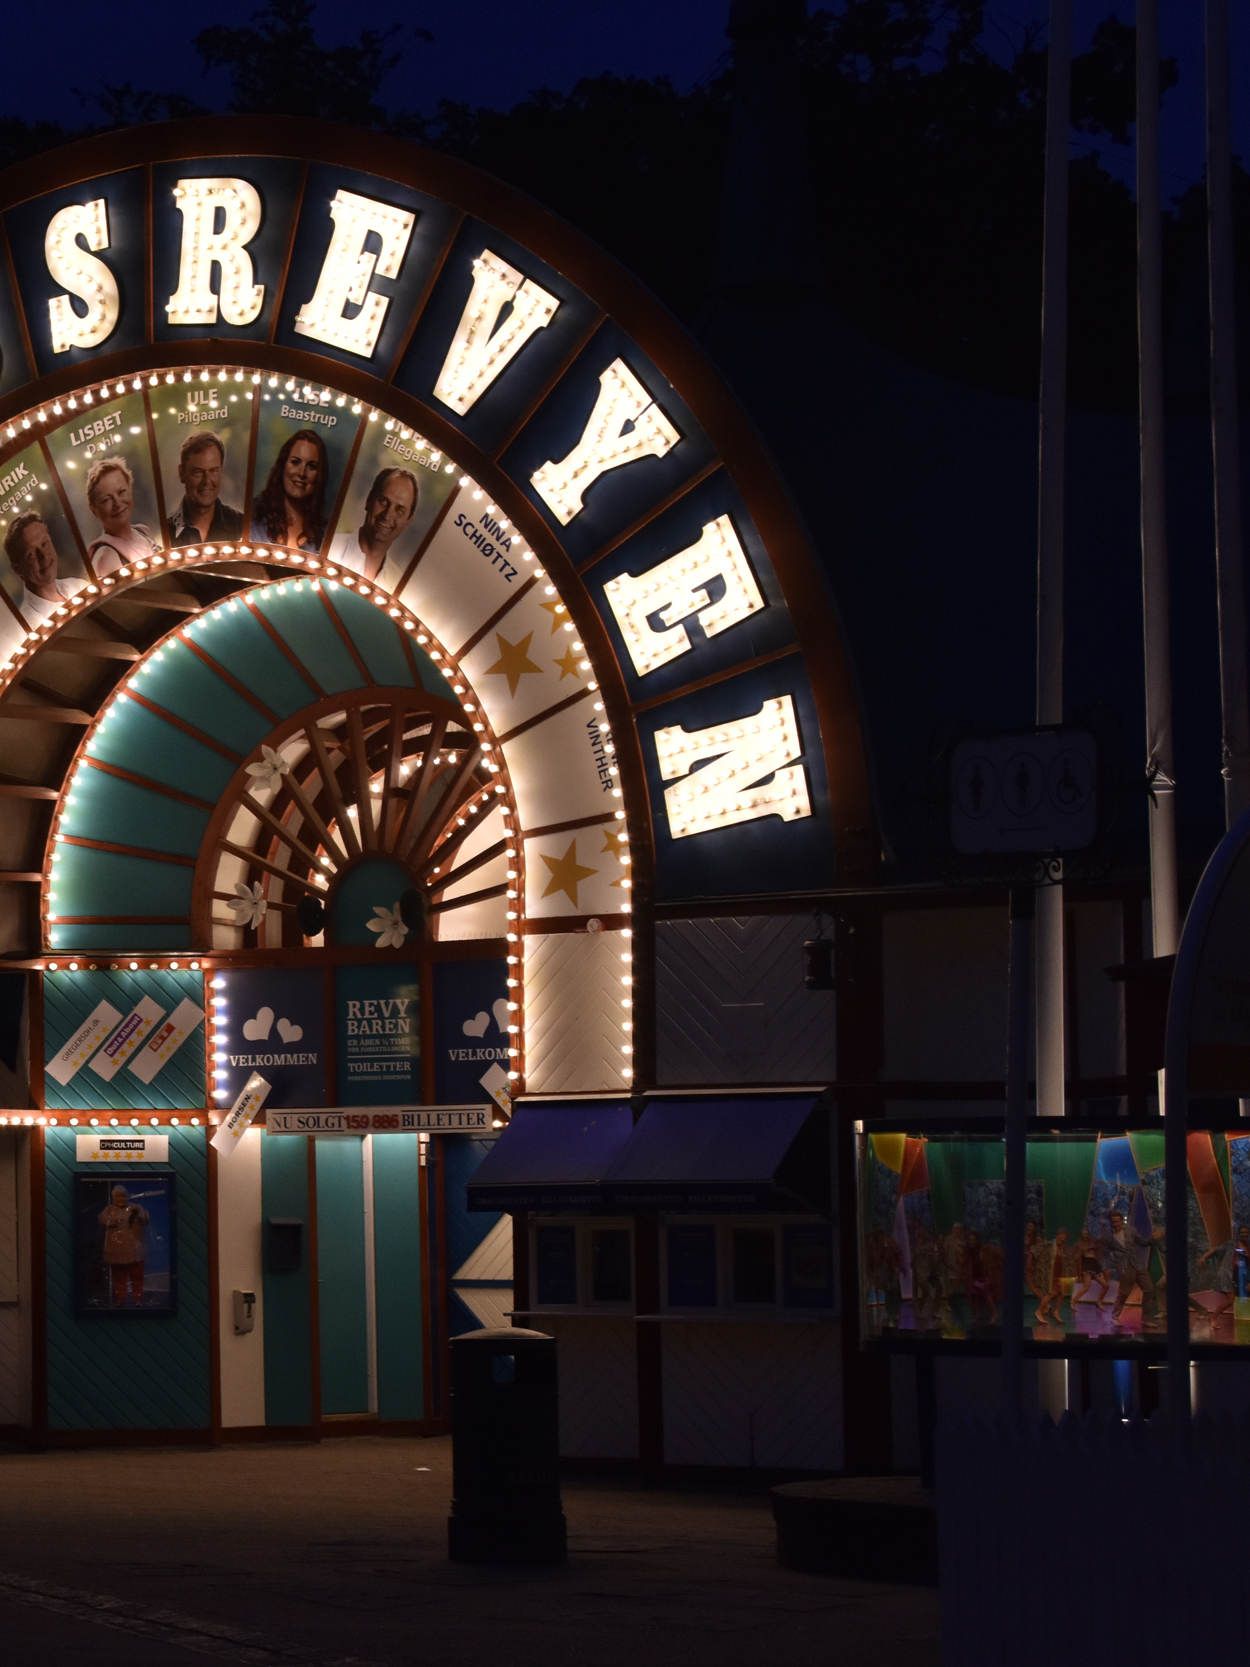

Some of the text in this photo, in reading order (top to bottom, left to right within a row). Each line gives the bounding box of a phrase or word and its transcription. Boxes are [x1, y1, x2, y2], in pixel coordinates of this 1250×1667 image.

[178, 406, 228, 425] Pilgaard
[281, 404, 338, 428] Baastrup
[69, 410, 122, 448] LISBET
[383, 434, 442, 472] Ellegaard
[479, 512, 512, 552] NINA
[454, 513, 518, 583] SCHIØTTZ
[586, 717, 614, 792] VINTHER
[347, 998, 410, 1019] REVY
[347, 1019, 410, 1035] BAREN
[62, 1019, 100, 1062] GREGERSDH.dk
[360, 1038, 380, 1046] ÅBEN
[230, 1052, 318, 1067] VELKOMMEN
[348, 1062, 411, 1072] TOILETTER
[272, 1112, 486, 1130] NU SOLGT 159 886 BILLETTER
